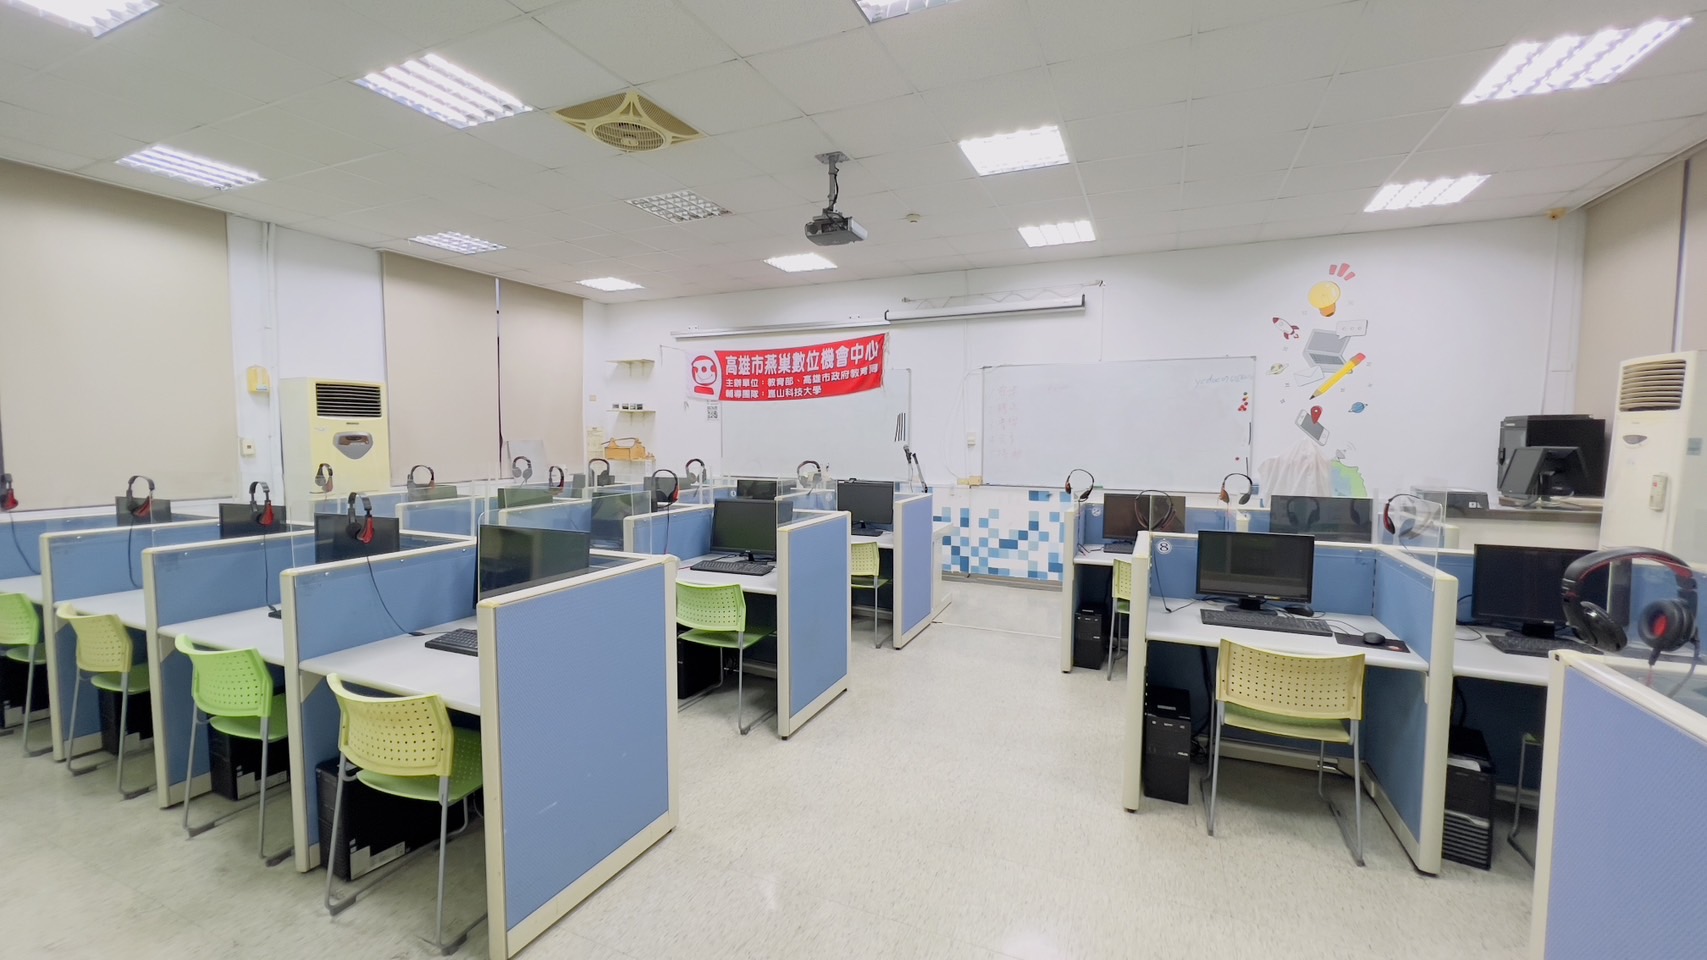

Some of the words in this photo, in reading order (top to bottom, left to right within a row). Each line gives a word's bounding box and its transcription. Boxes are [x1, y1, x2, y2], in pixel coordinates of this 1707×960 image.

[725, 340, 879, 375] 高雄市燕巢數位機會中心
[1159, 542, 1169, 551] 8
